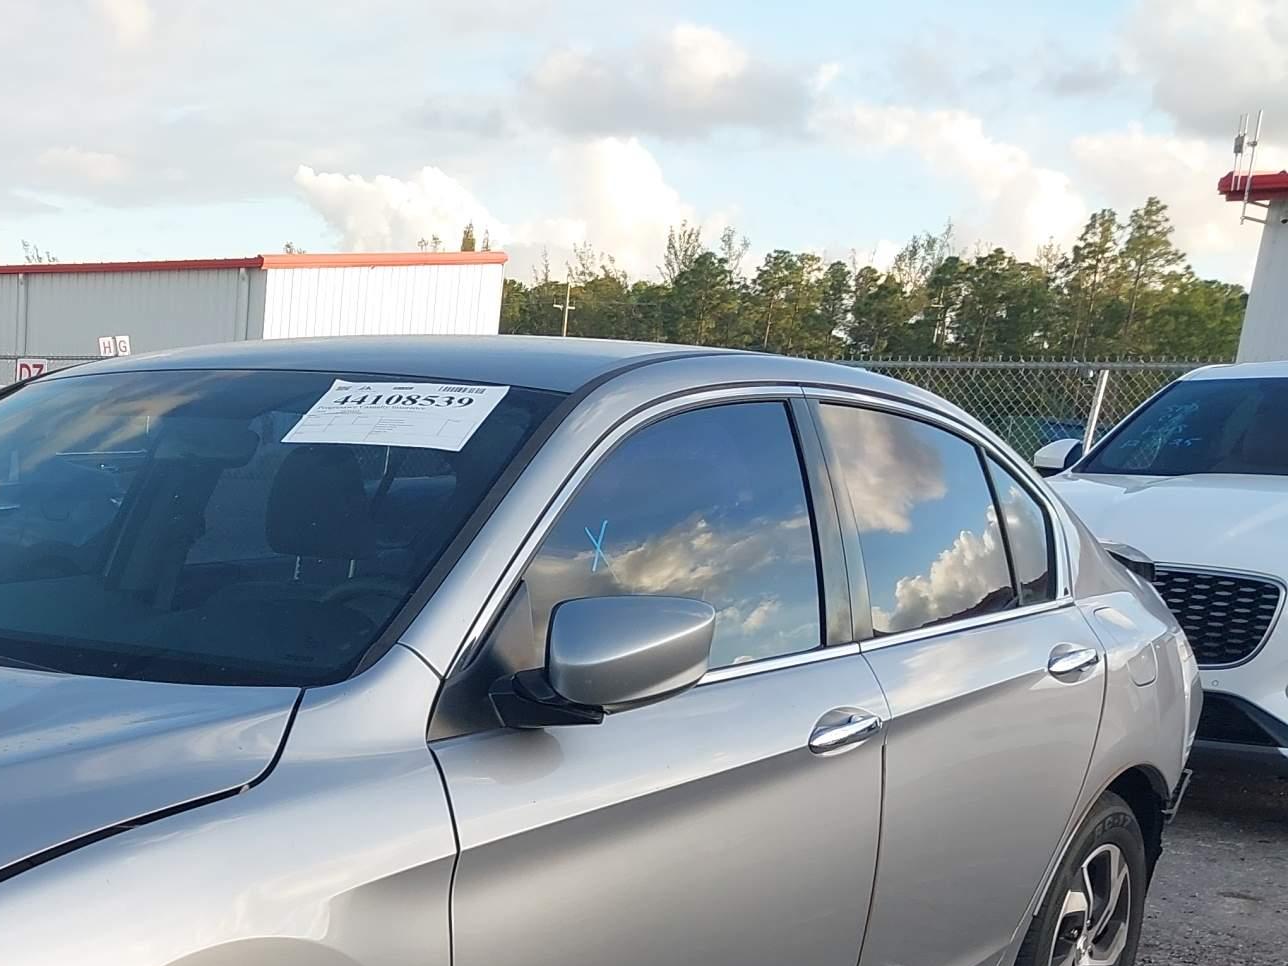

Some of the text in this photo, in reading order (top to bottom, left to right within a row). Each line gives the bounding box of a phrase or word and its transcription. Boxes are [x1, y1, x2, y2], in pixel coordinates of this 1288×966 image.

[103, 340, 128, 354] H G
[333, 394, 474, 408] 44108539
